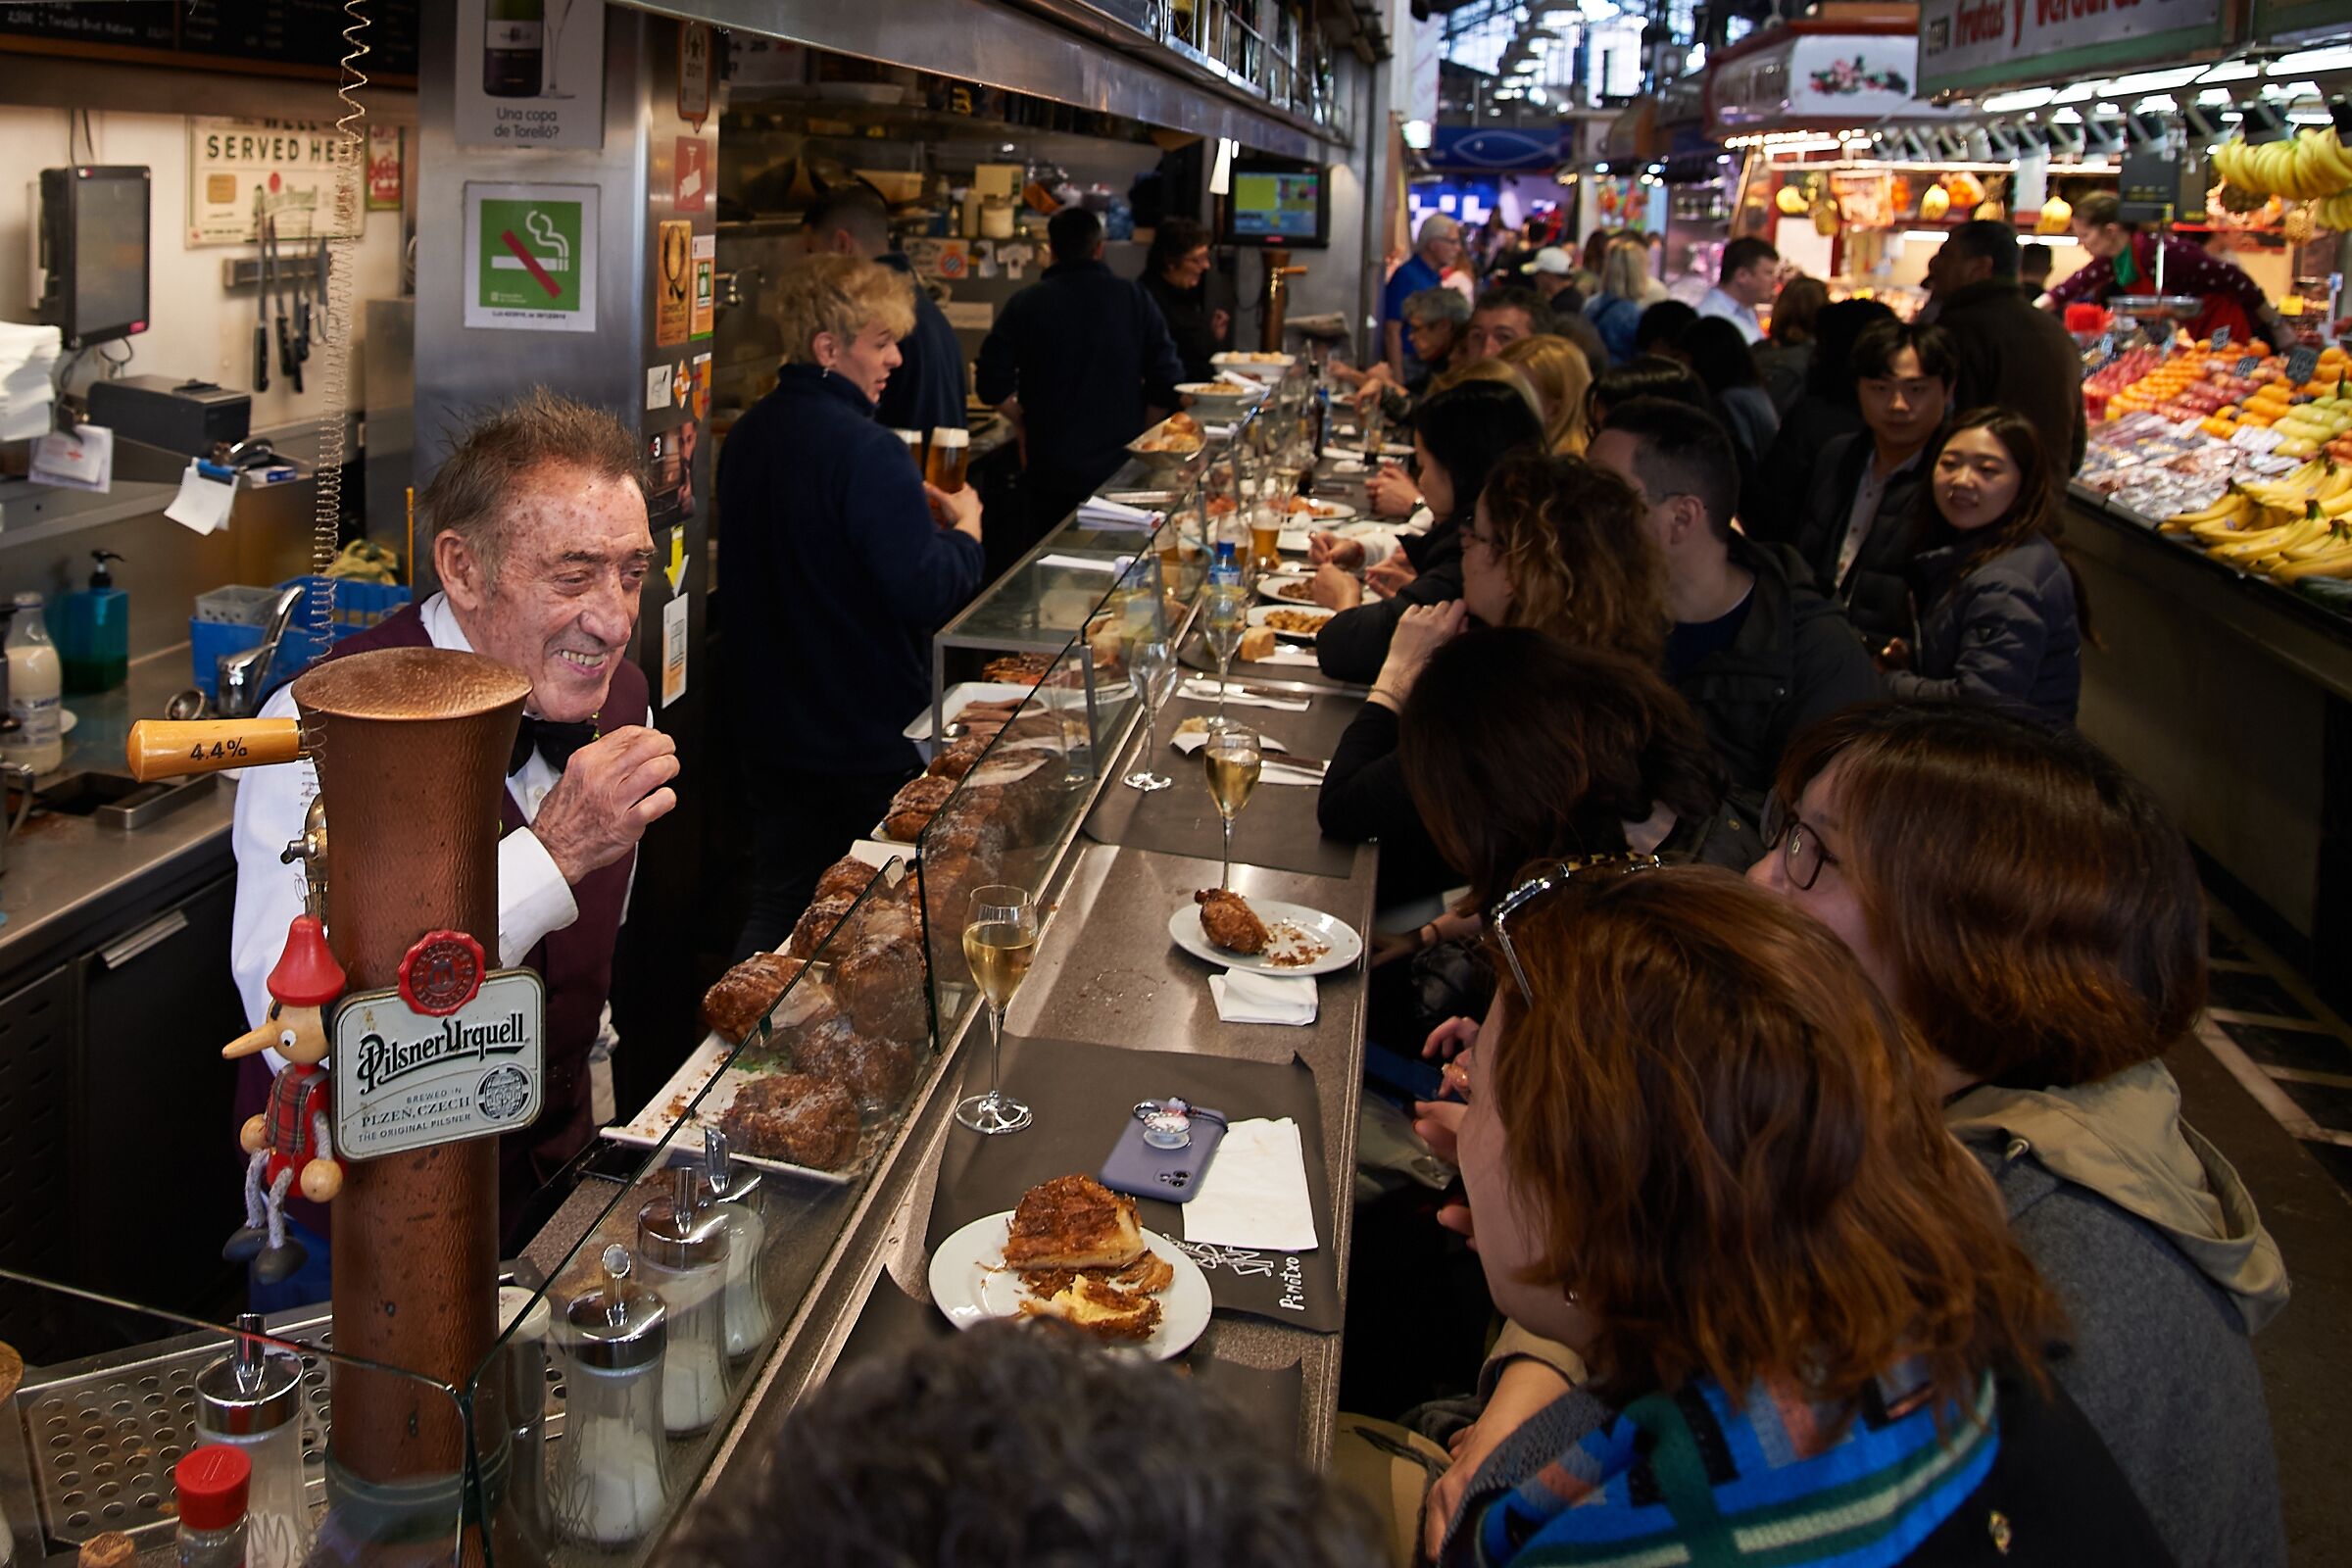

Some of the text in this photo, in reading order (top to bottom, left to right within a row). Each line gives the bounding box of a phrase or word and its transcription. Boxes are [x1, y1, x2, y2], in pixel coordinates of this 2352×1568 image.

[497, 107, 558, 123] Una copa
[494, 124, 511, 137] de
[207, 135, 300, 160] SERVED
[190, 737, 248, 760] 4.4%
[357, 1012, 524, 1096] Pilsner Urquell
[407, 1090, 447, 1103] BREWED
[416, 1097, 469, 1115] CZECH
[359, 1113, 470, 1143] THE ORIGINAL PILSNER
